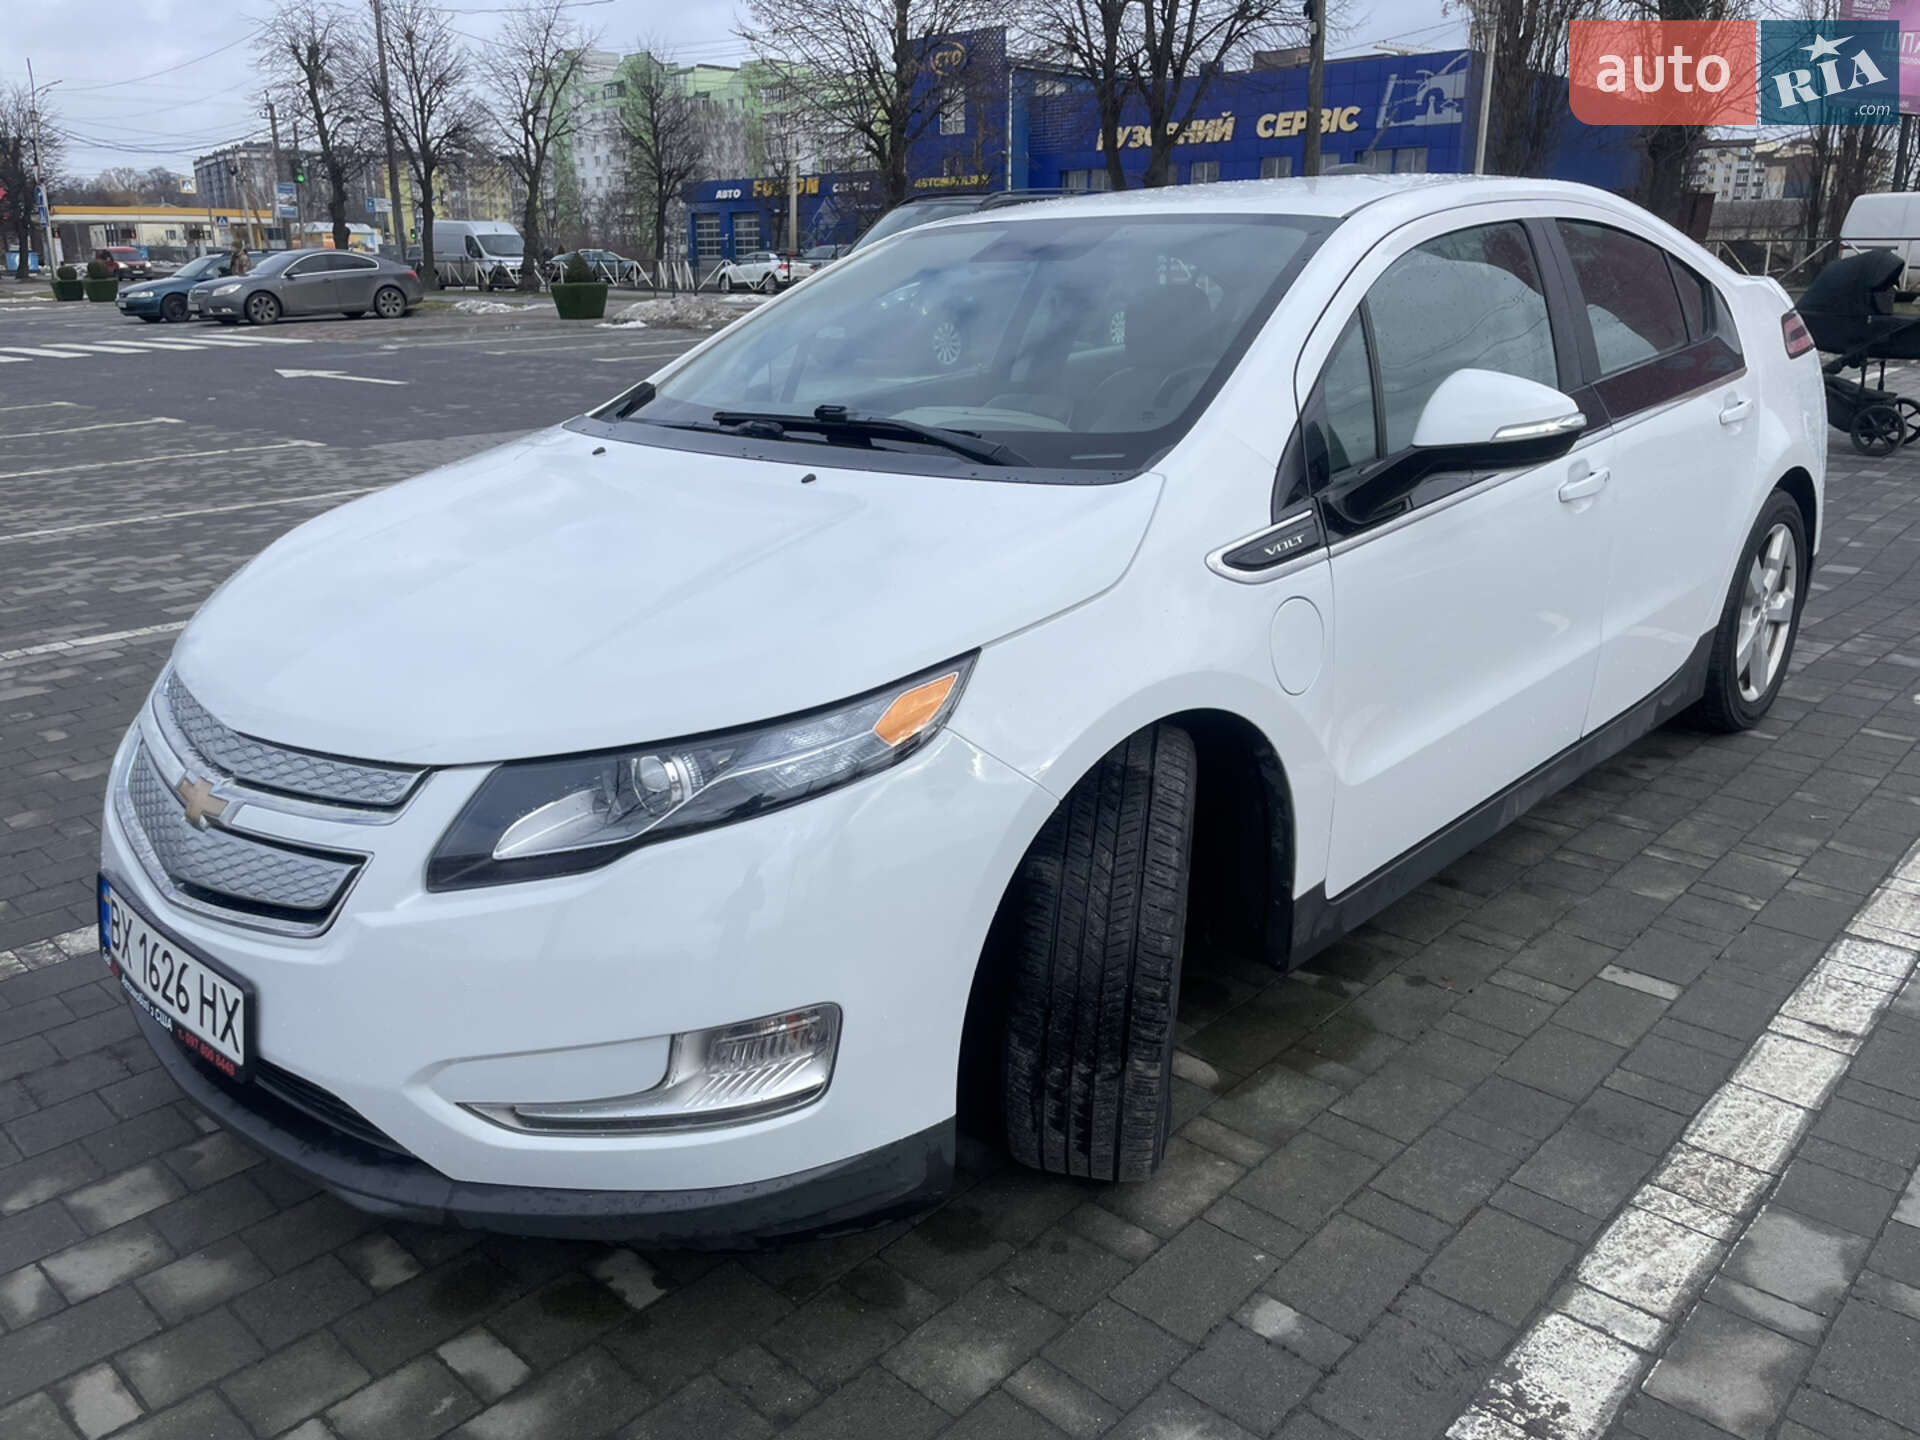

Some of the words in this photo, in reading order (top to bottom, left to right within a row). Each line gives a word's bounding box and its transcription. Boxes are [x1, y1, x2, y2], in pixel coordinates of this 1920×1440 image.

[715, 189, 742, 200] АВТО
[1265, 534, 1305, 556] VOLT
[139, 932, 190, 1015] 1626
[199, 973, 241, 1054] HX
[154, 1008, 173, 1033] США
